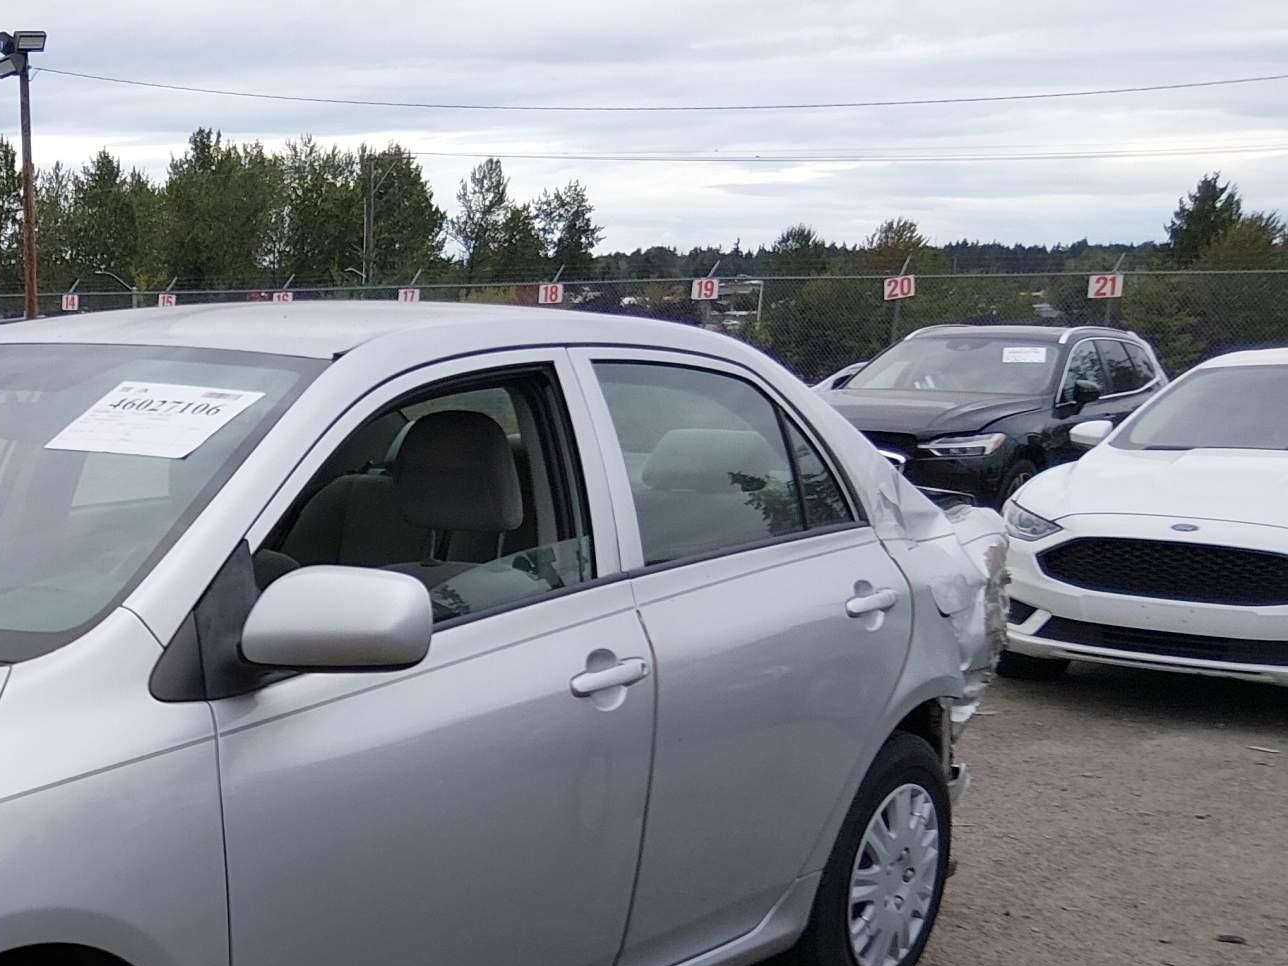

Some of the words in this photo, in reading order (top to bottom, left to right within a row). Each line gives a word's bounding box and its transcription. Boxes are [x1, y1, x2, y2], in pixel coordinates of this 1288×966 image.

[543, 285, 558, 302] 18
[697, 280, 714, 298] 19
[887, 277, 911, 298] 20
[1095, 276, 1116, 297] 21
[65, 295, 75, 309] 14
[162, 295, 173, 306] 15
[403, 290, 415, 302] 17
[109, 397, 223, 416] 46027106
